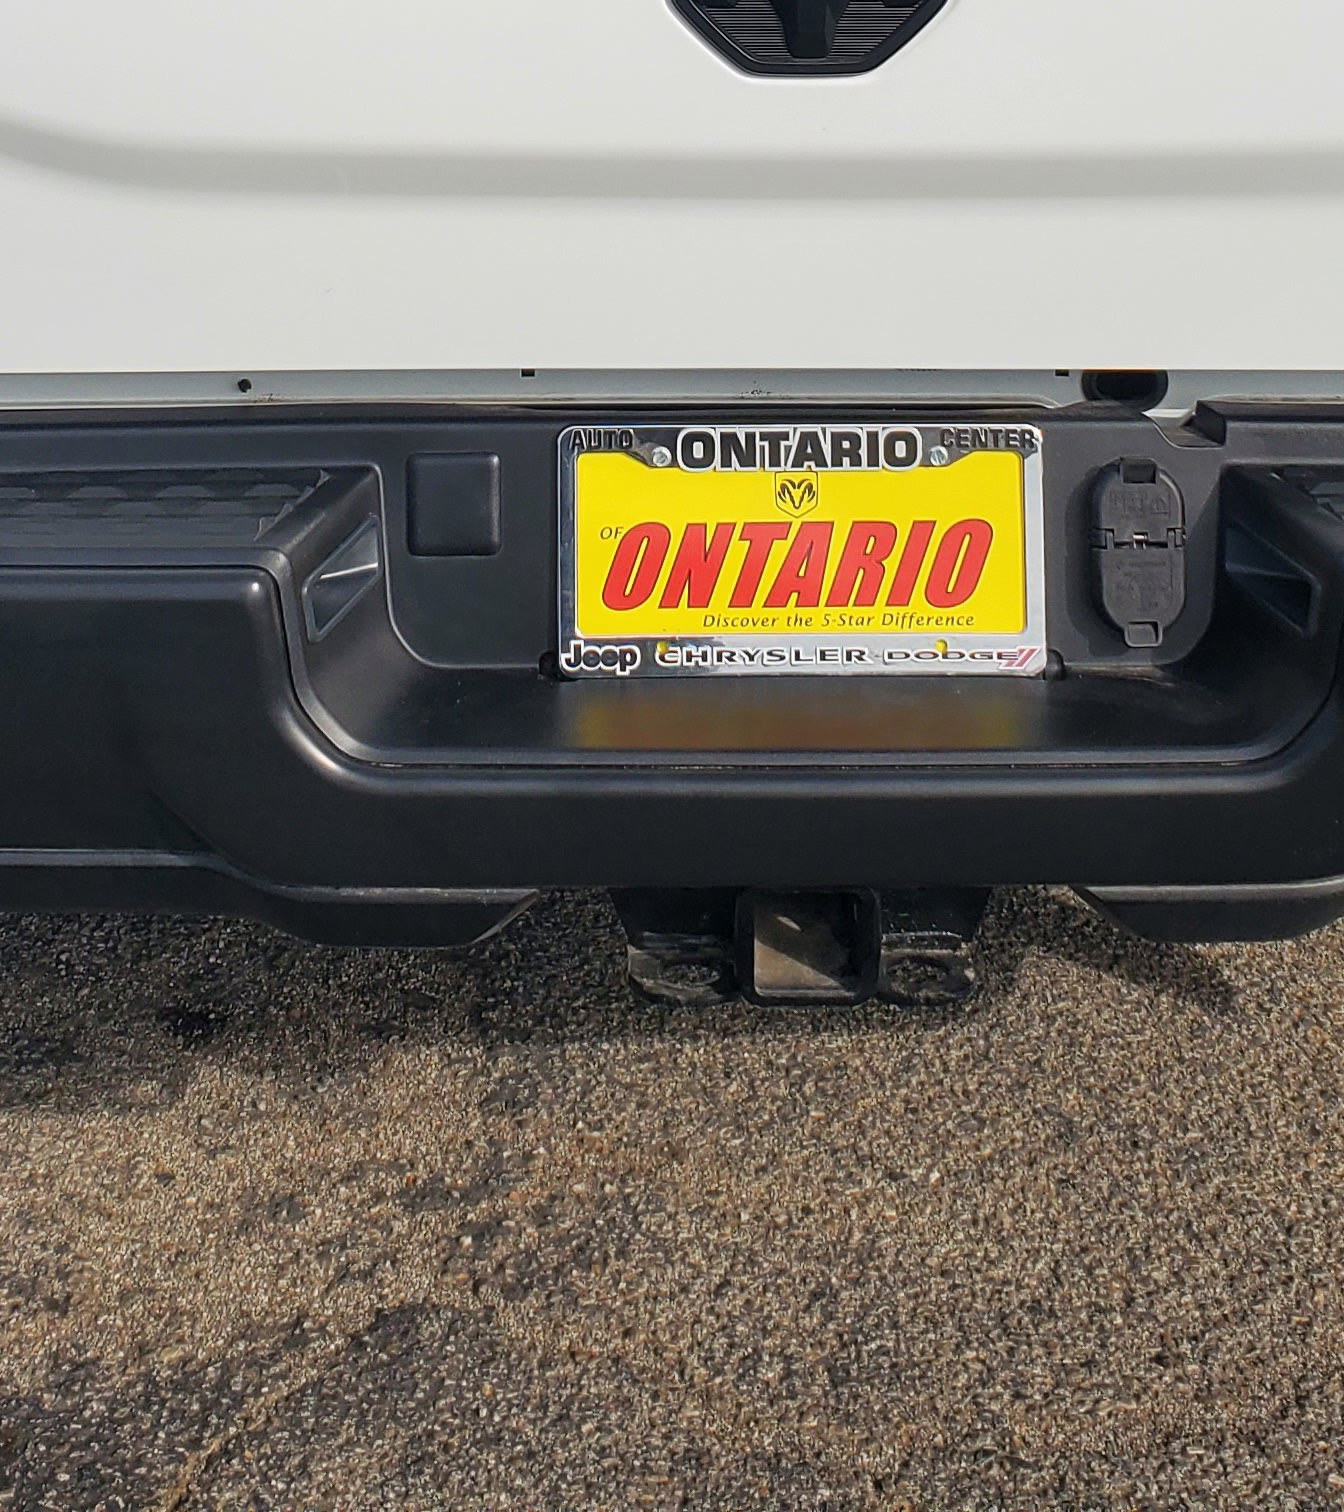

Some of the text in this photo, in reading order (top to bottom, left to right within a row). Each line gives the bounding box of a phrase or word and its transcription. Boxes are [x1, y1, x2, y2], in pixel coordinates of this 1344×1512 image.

[569, 427, 1035, 472] AUTO ONTARIO CENTER
[599, 518, 994, 611] OF ONTARIO
[703, 611, 975, 629] Discover the 5-Star Difference
[562, 641, 1021, 674] Jeep CHRYSLER DODGE
